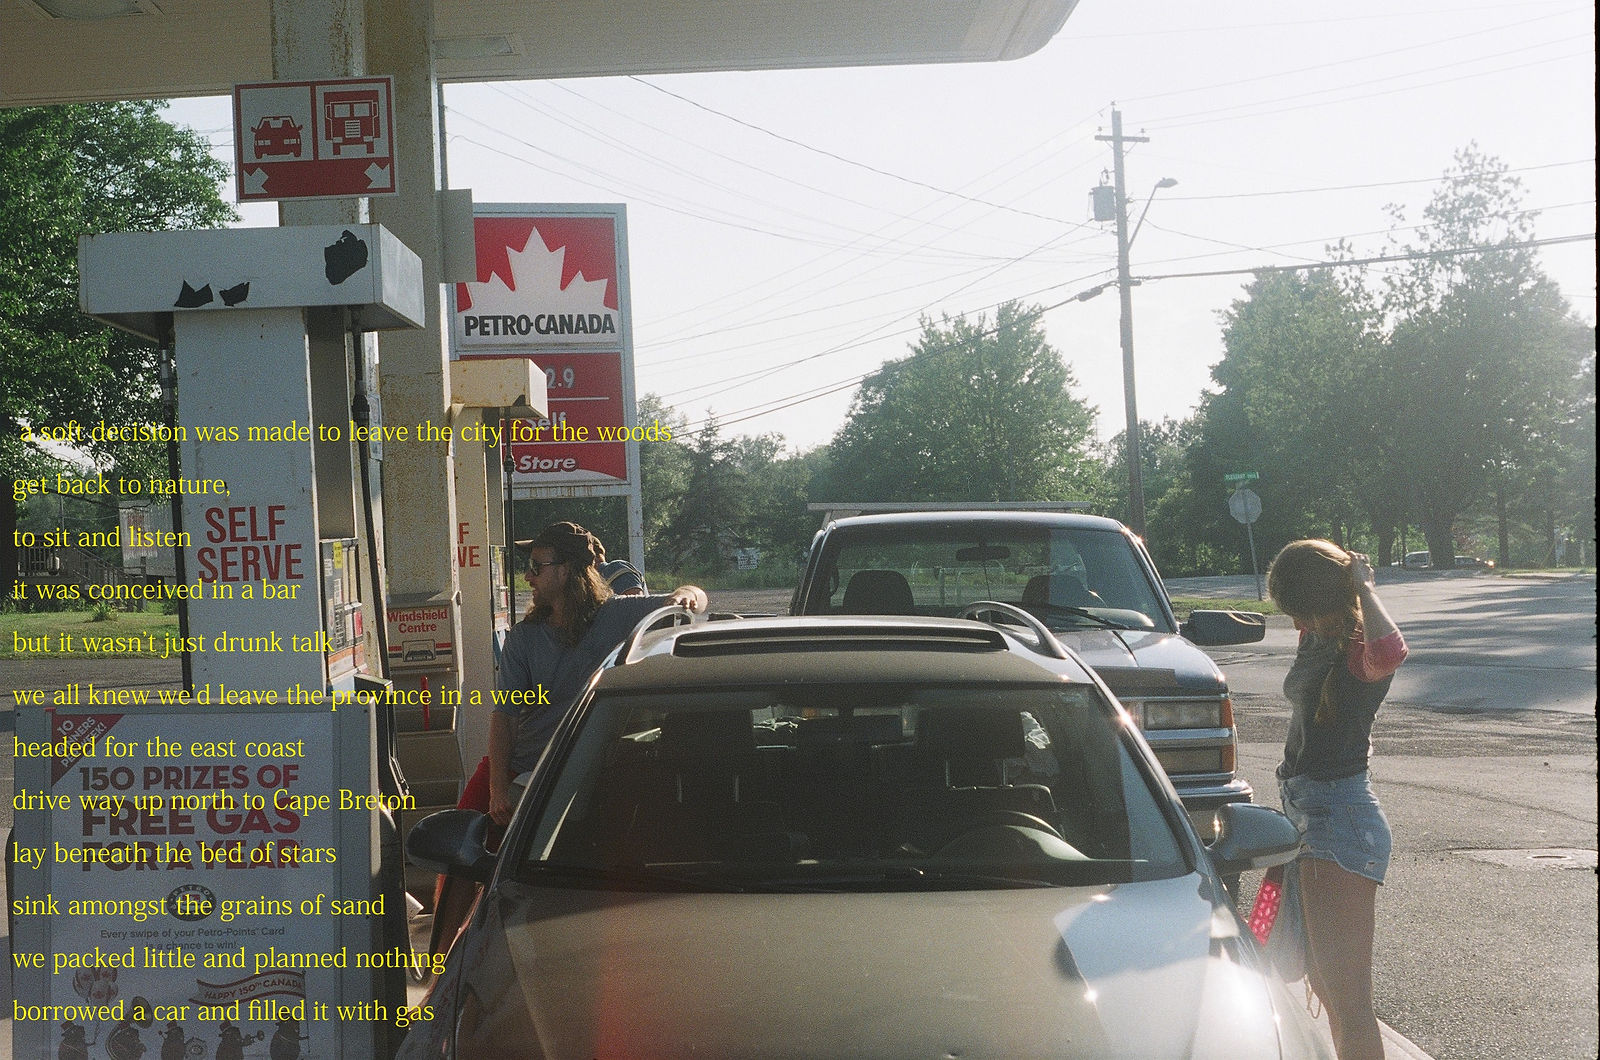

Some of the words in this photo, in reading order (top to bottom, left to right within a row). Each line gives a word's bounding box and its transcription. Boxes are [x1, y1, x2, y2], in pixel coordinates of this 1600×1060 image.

[464, 313, 616, 336] PETRO-CANADA
[520, 454, 577, 472] Store
[205, 505, 286, 544] SELF
[197, 544, 304, 583] SERVE
[386, 609, 448, 623] Windshield
[398, 622, 437, 634] Centre
[56, 718, 76, 737] 10
[79, 766, 135, 791] 150
[143, 765, 250, 790] PRIZES
[256, 764, 299, 789] OF
[82, 799, 195, 836] FREE
[206, 797, 301, 834] GAS
[82, 841, 159, 871] FOR
[166, 841, 194, 870] A
[100, 929, 127, 940] Every
[130, 930, 159, 939] swipe
[161, 928, 172, 938] of
[174, 929, 195, 938] your
[261, 926, 285, 935] Card
[204, 940, 215, 949] to
[204, 991, 236, 999] HAPPY
